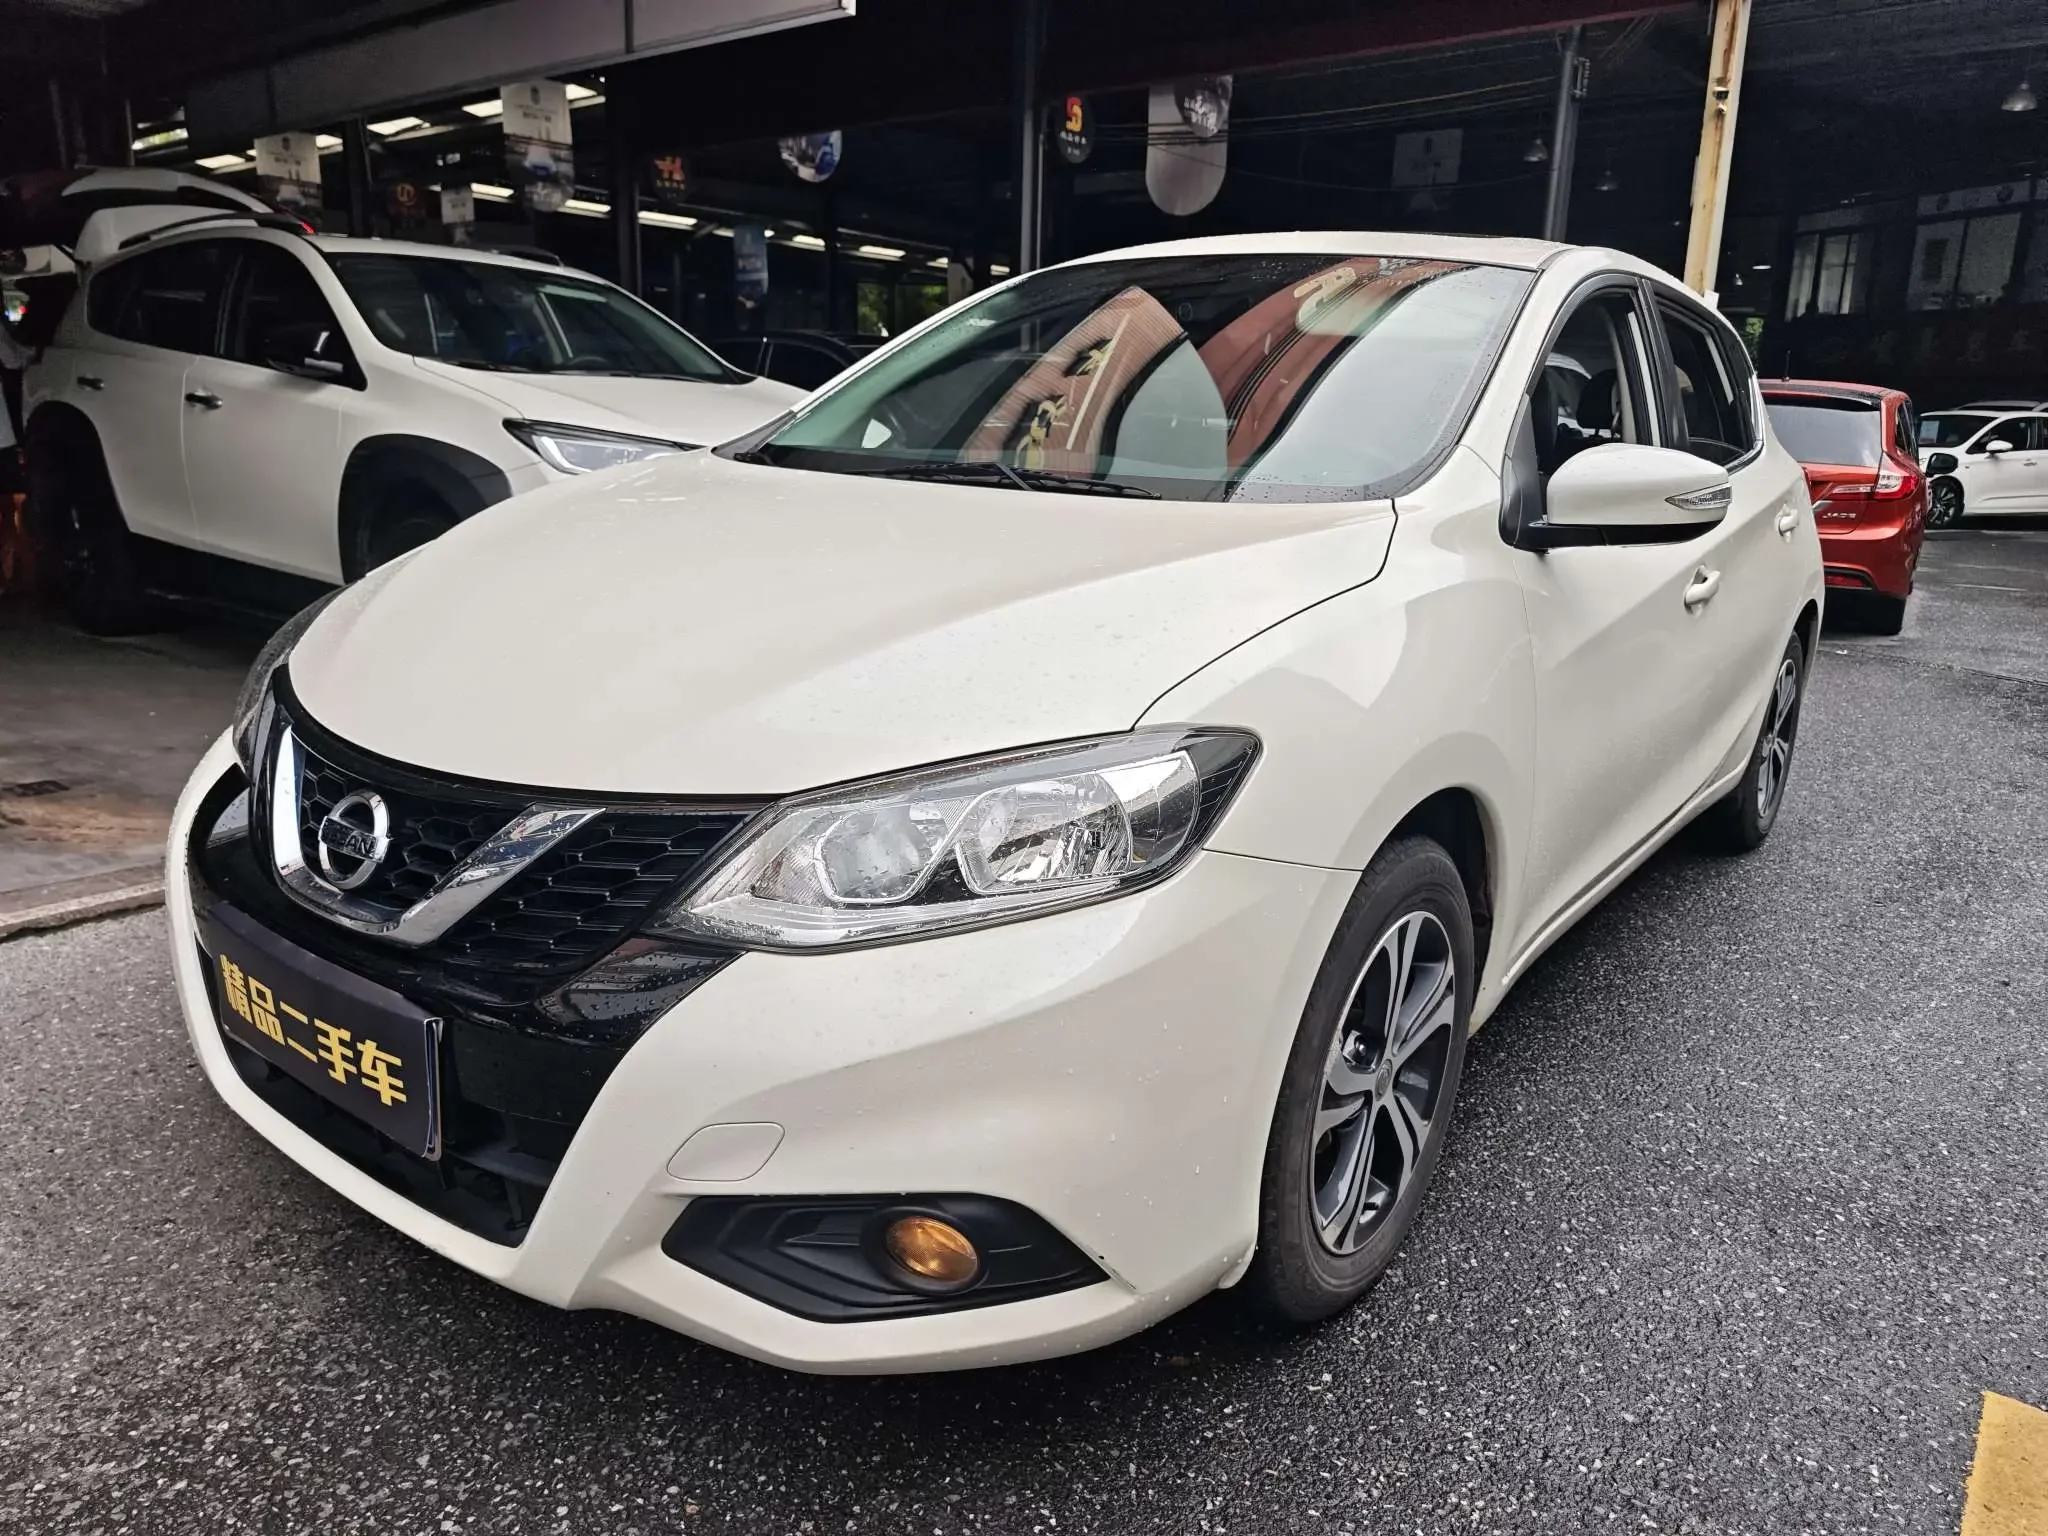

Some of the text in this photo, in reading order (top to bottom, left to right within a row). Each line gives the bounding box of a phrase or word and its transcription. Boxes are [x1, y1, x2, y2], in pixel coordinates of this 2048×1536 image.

[219, 954, 407, 1107] 精品二手车
